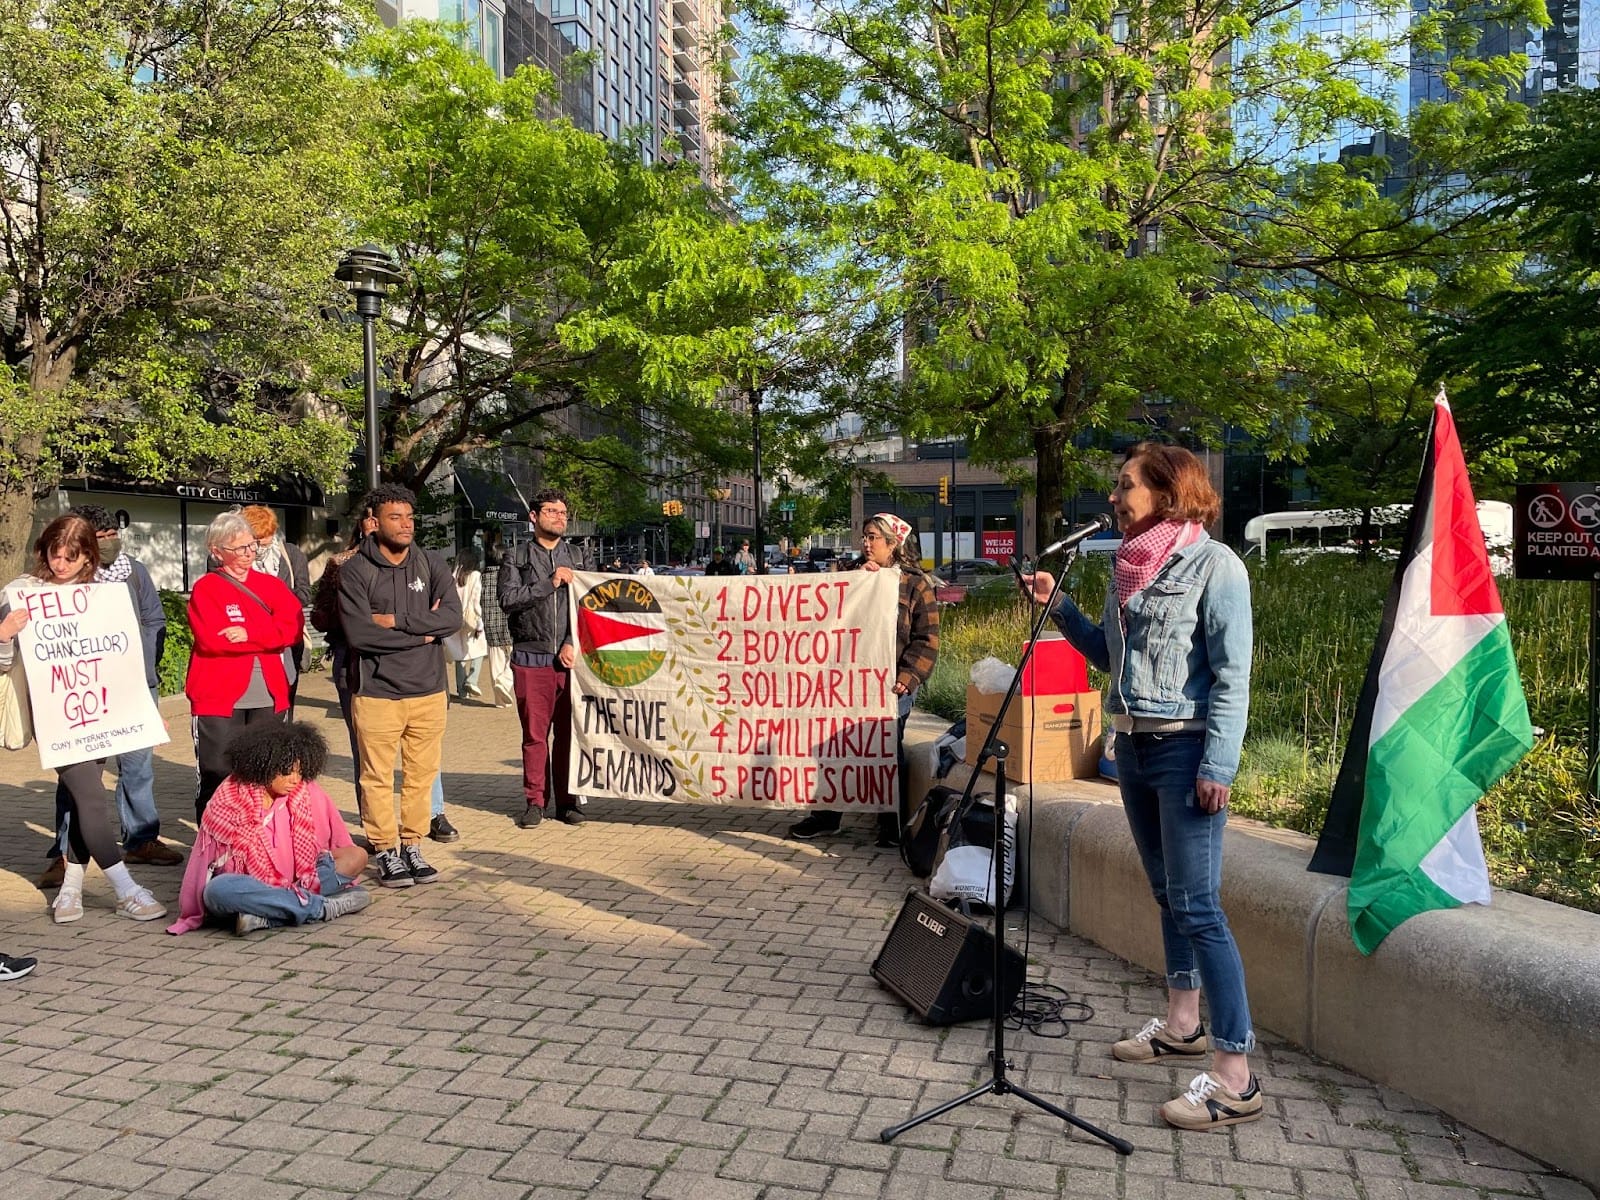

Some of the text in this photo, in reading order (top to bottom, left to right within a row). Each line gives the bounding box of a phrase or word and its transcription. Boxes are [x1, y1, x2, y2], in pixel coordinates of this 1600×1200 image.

[176, 485, 260, 500] CITY CHEMIST
[984, 538, 1014, 547] WELLS
[985, 547, 1014, 555] FARGO
[1527, 532, 1562, 543] KEEP
[1564, 532, 1593, 543] OUT
[1527, 545, 1588, 556] PLANTED
[17, 585, 91, 621] "FELO"
[583, 580, 654, 611] CUNY FOR
[716, 581, 850, 622] 1. DIVEST
[34, 620, 80, 641] (CUNY
[34, 631, 129, 662] CHANCELLOR)
[716, 628, 862, 666] 2. BOYCOTT
[51, 658, 103, 693] MUST
[716, 668, 889, 709] 3. SOLIDARITY
[64, 687, 109, 725] GO!
[581, 695, 667, 741] THE FIVE
[51, 723, 145, 752] CUNY INTERNATIONALIST
[85, 740, 113, 753] CLUBS
[710, 716, 894, 759] 4. DEMILITARIZE
[577, 748, 677, 797] DEMANDS
[711, 763, 898, 806] 5. PEOPLE'S CUNY
[916, 911, 947, 937] CUBE
